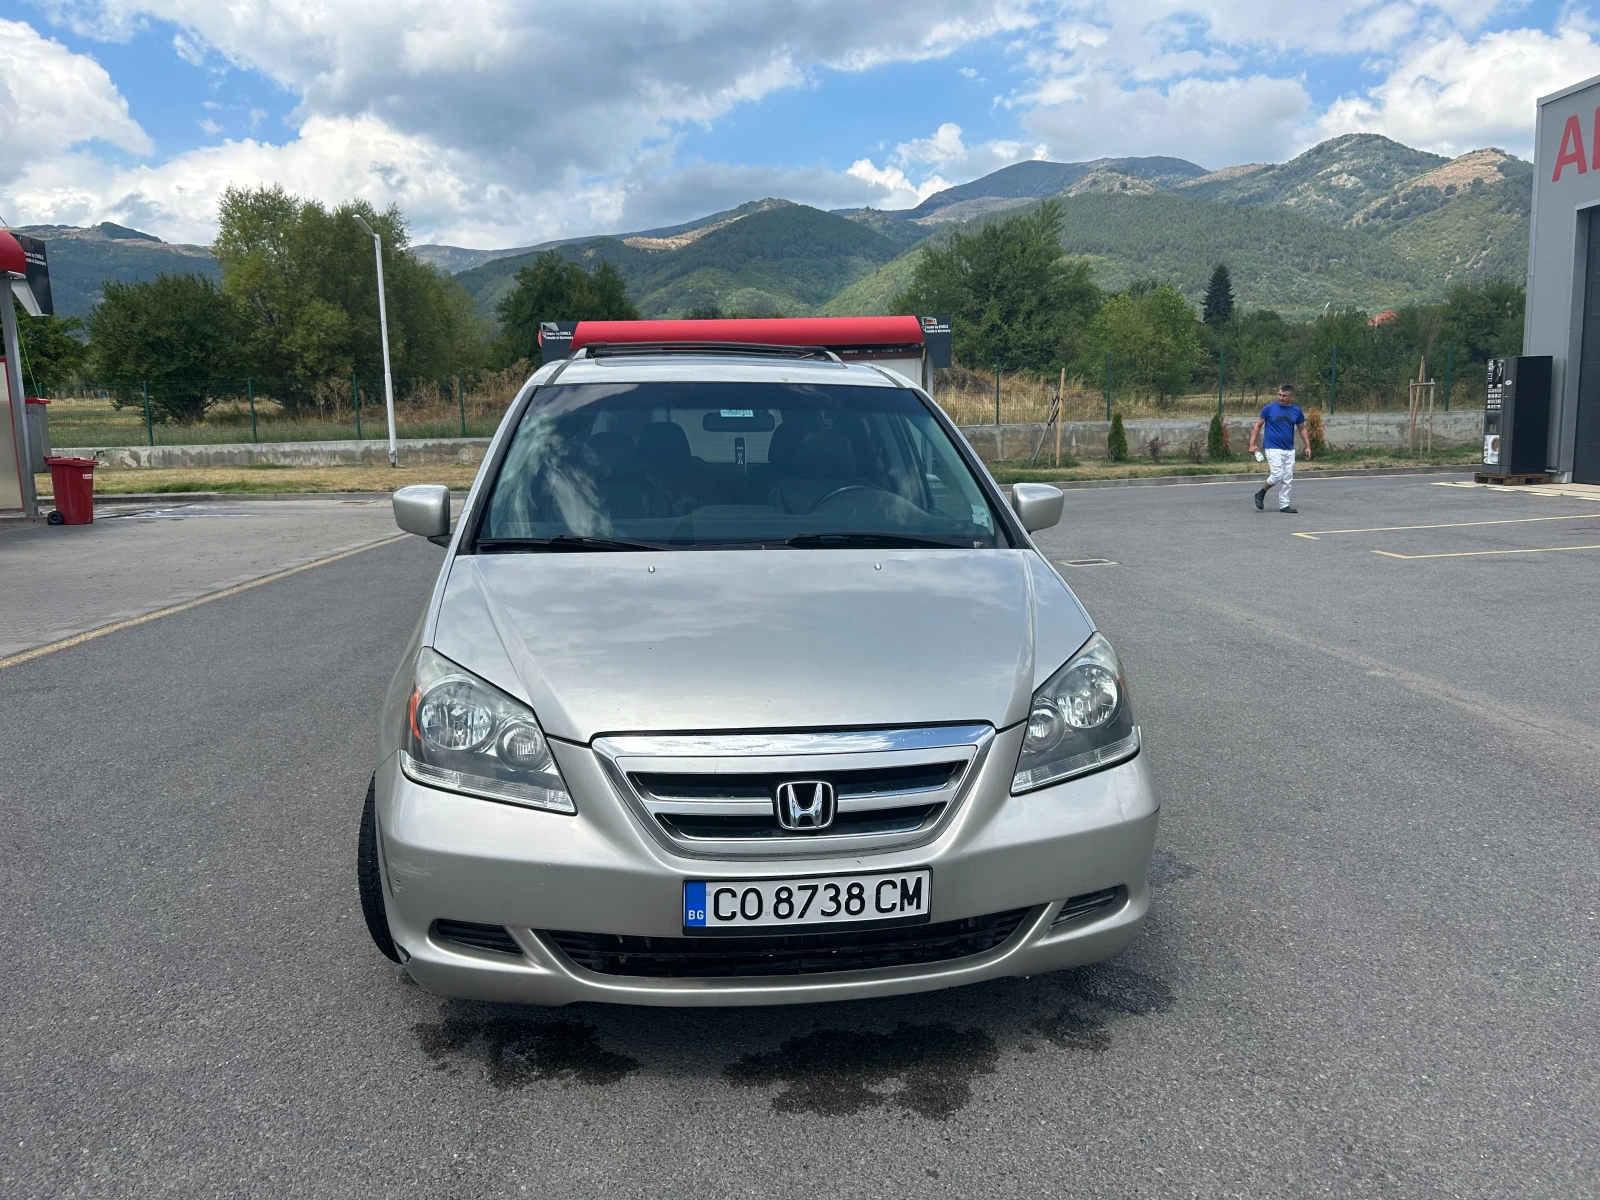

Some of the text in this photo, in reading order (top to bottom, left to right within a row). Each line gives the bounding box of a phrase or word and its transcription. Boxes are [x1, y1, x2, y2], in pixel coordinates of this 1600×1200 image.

[713, 876, 923, 921] CO 8738 CM
[688, 909, 705, 921] BG
